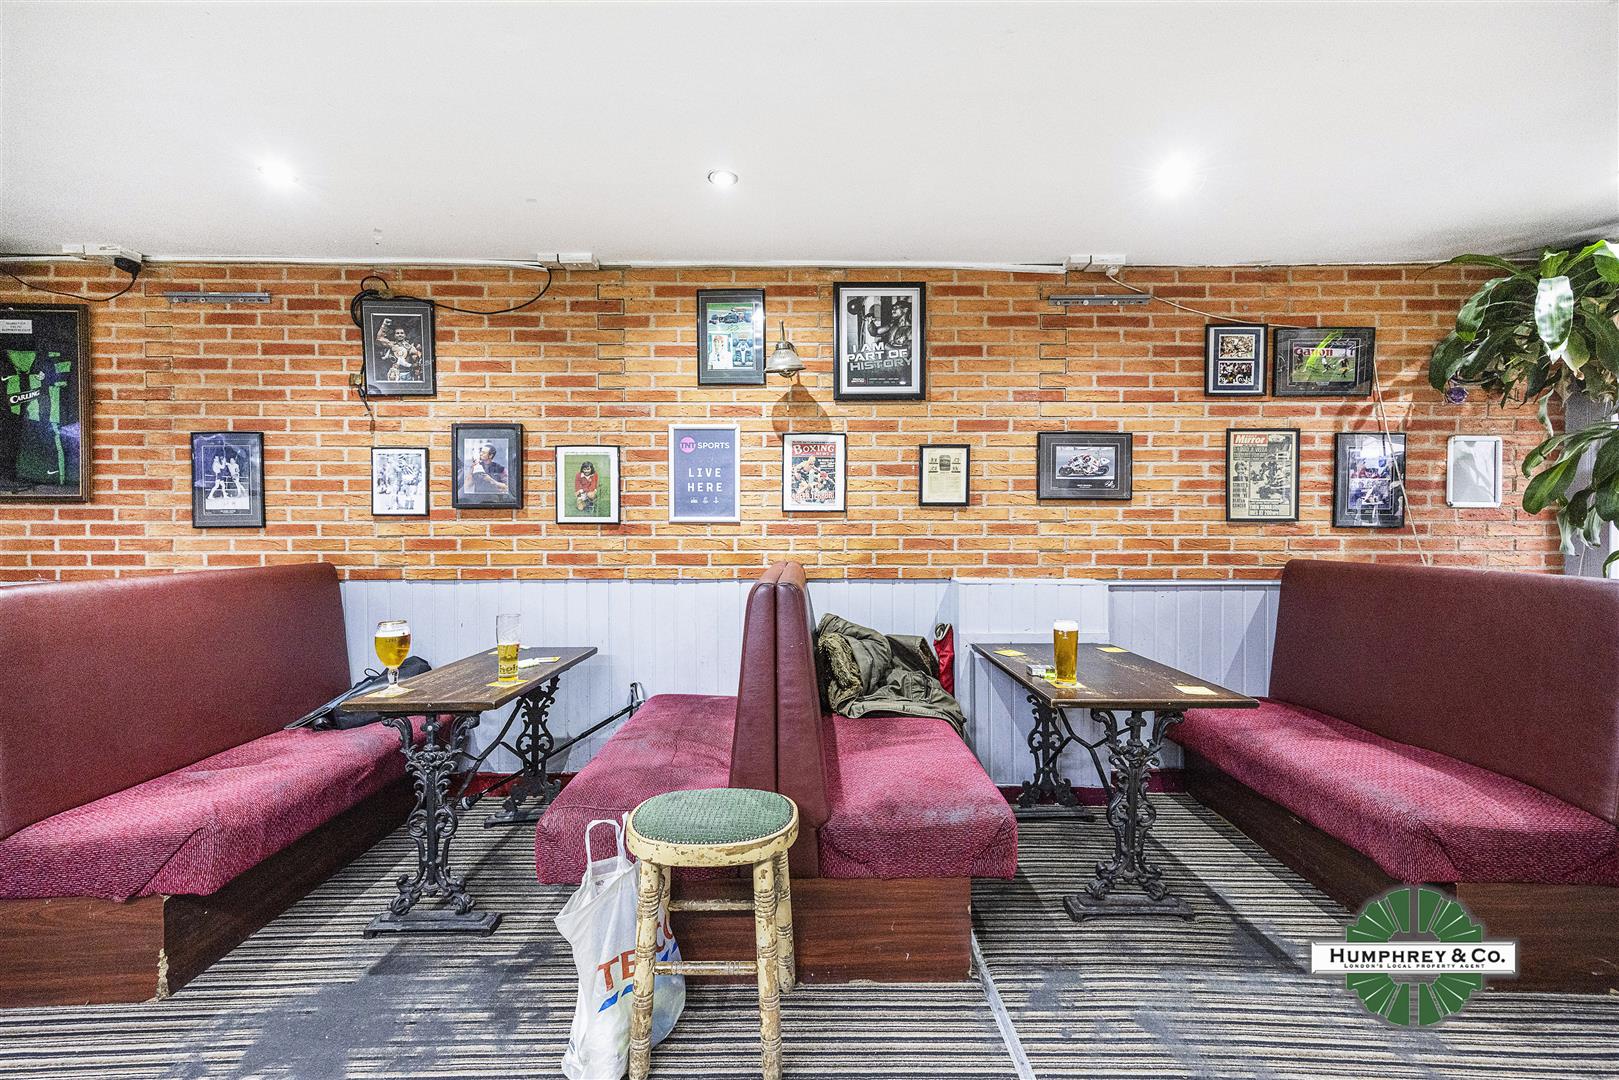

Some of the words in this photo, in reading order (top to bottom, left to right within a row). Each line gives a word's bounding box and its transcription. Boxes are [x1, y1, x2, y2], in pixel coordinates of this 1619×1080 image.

[852, 345, 857, 353] I
[861, 342, 885, 352] AM
[847, 351, 885, 363] PART
[888, 349, 908, 359] OF
[850, 357, 913, 371] HISTORY
[10, 390, 40, 403] CARLING
[1235, 435, 1265, 443] Mirror
[792, 444, 835, 455] BOXING
[688, 468, 721, 478] LIVE
[687, 482, 723, 492] HERE
[597, 914, 674, 992] TEC
